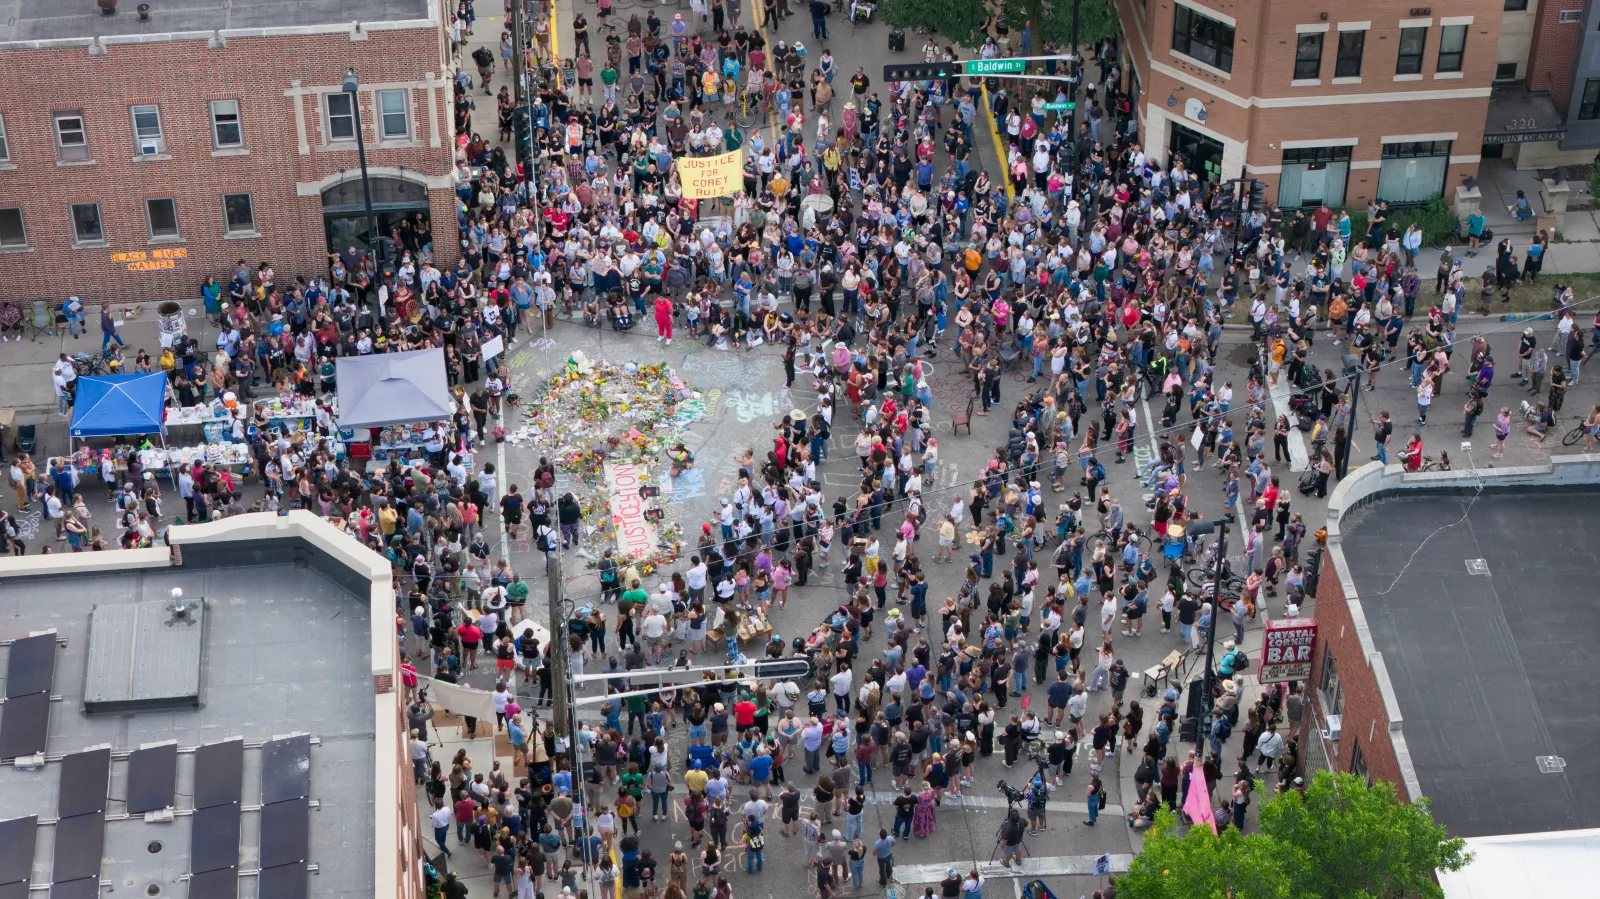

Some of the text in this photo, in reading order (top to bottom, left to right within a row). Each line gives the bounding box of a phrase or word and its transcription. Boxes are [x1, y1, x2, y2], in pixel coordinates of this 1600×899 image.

[977, 61, 1013, 72] Baldwin
[1511, 118, 1536, 129] 320
[1483, 131, 1565, 145] ALDWIN CORNERS
[684, 153, 734, 168] JUSTICE
[701, 168, 718, 177] FOR
[692, 175, 728, 187] COREY
[695, 186, 726, 197] RUIZ
[111, 249, 187, 262] BLACK LIVES
[129, 261, 173, 270] MATTER
[1268, 628, 1316, 640] CRYSTAL
[1268, 637, 1313, 647] CORNER
[1267, 645, 1311, 664] BAR
